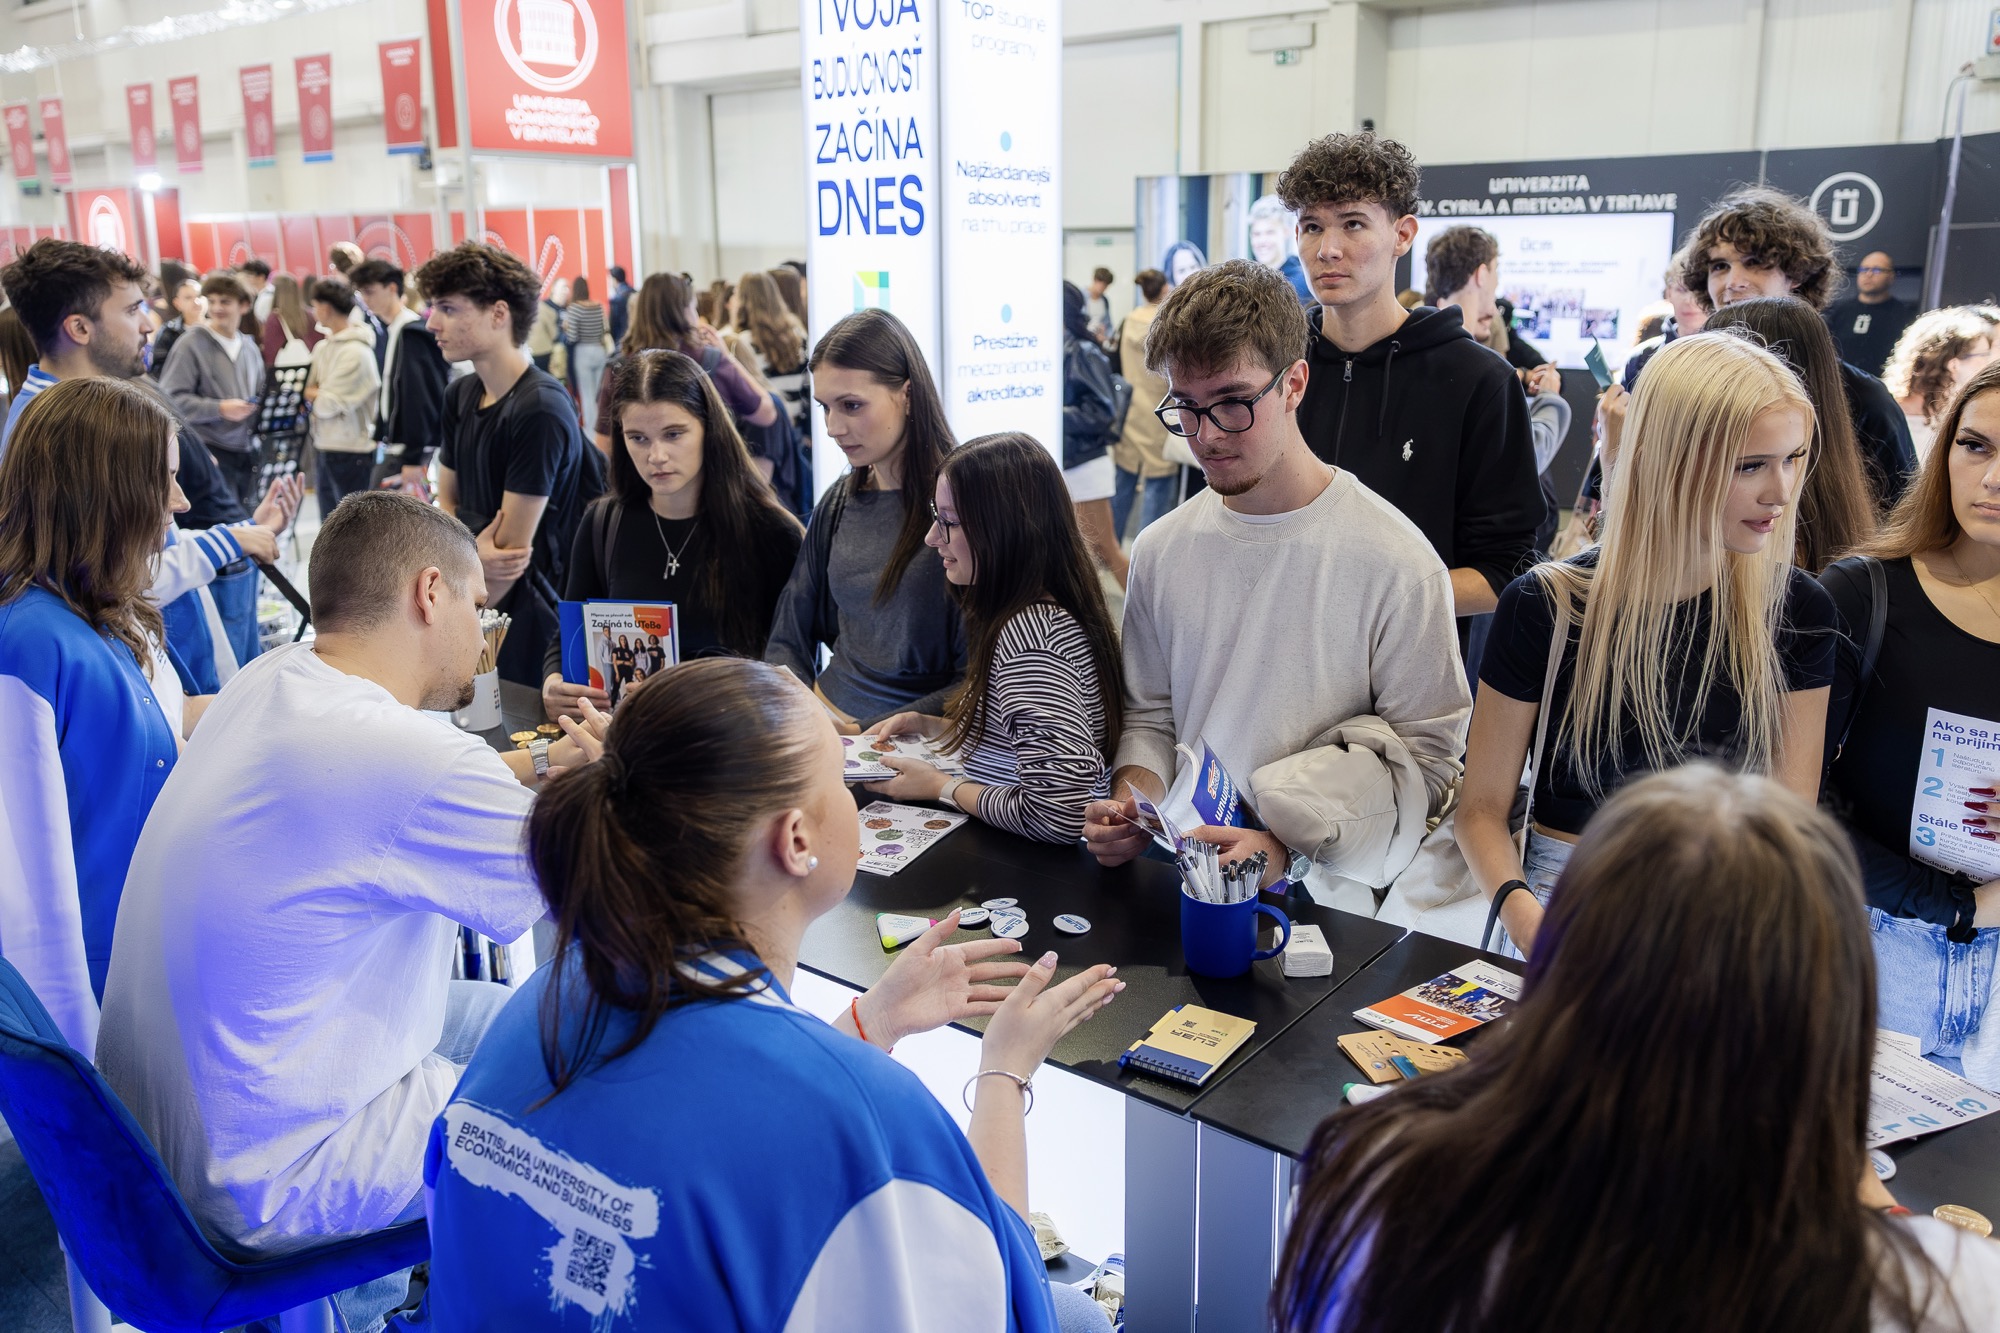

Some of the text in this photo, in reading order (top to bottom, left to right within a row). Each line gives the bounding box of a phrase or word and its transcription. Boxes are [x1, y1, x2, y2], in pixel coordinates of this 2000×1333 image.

[816, 106, 923, 164] ZAČÍNA
[1489, 175, 1590, 194] UNIVERZITA
[818, 174, 925, 237] DNES
[1588, 195, 1604, 213] V
[1932, 730, 1951, 742] na
[1933, 720, 1964, 734] Ako
[1969, 728, 1988, 738] sa
[1931, 748, 1945, 768] 1
[1922, 776, 1944, 799] 2
[1918, 813, 1958, 830] Stále
[1915, 826, 1936, 847] 3
[1921, 1094, 1967, 1119] Stále
[1956, 1098, 1988, 1114] 3
[1880, 1122, 1902, 1133] 1
[1906, 1113, 1942, 1128] 2
[460, 1121, 634, 1215] BRATISLAVA UNIVERSITY OF
[454, 1135, 633, 1233] ECONOMICS AND BUSINESS
